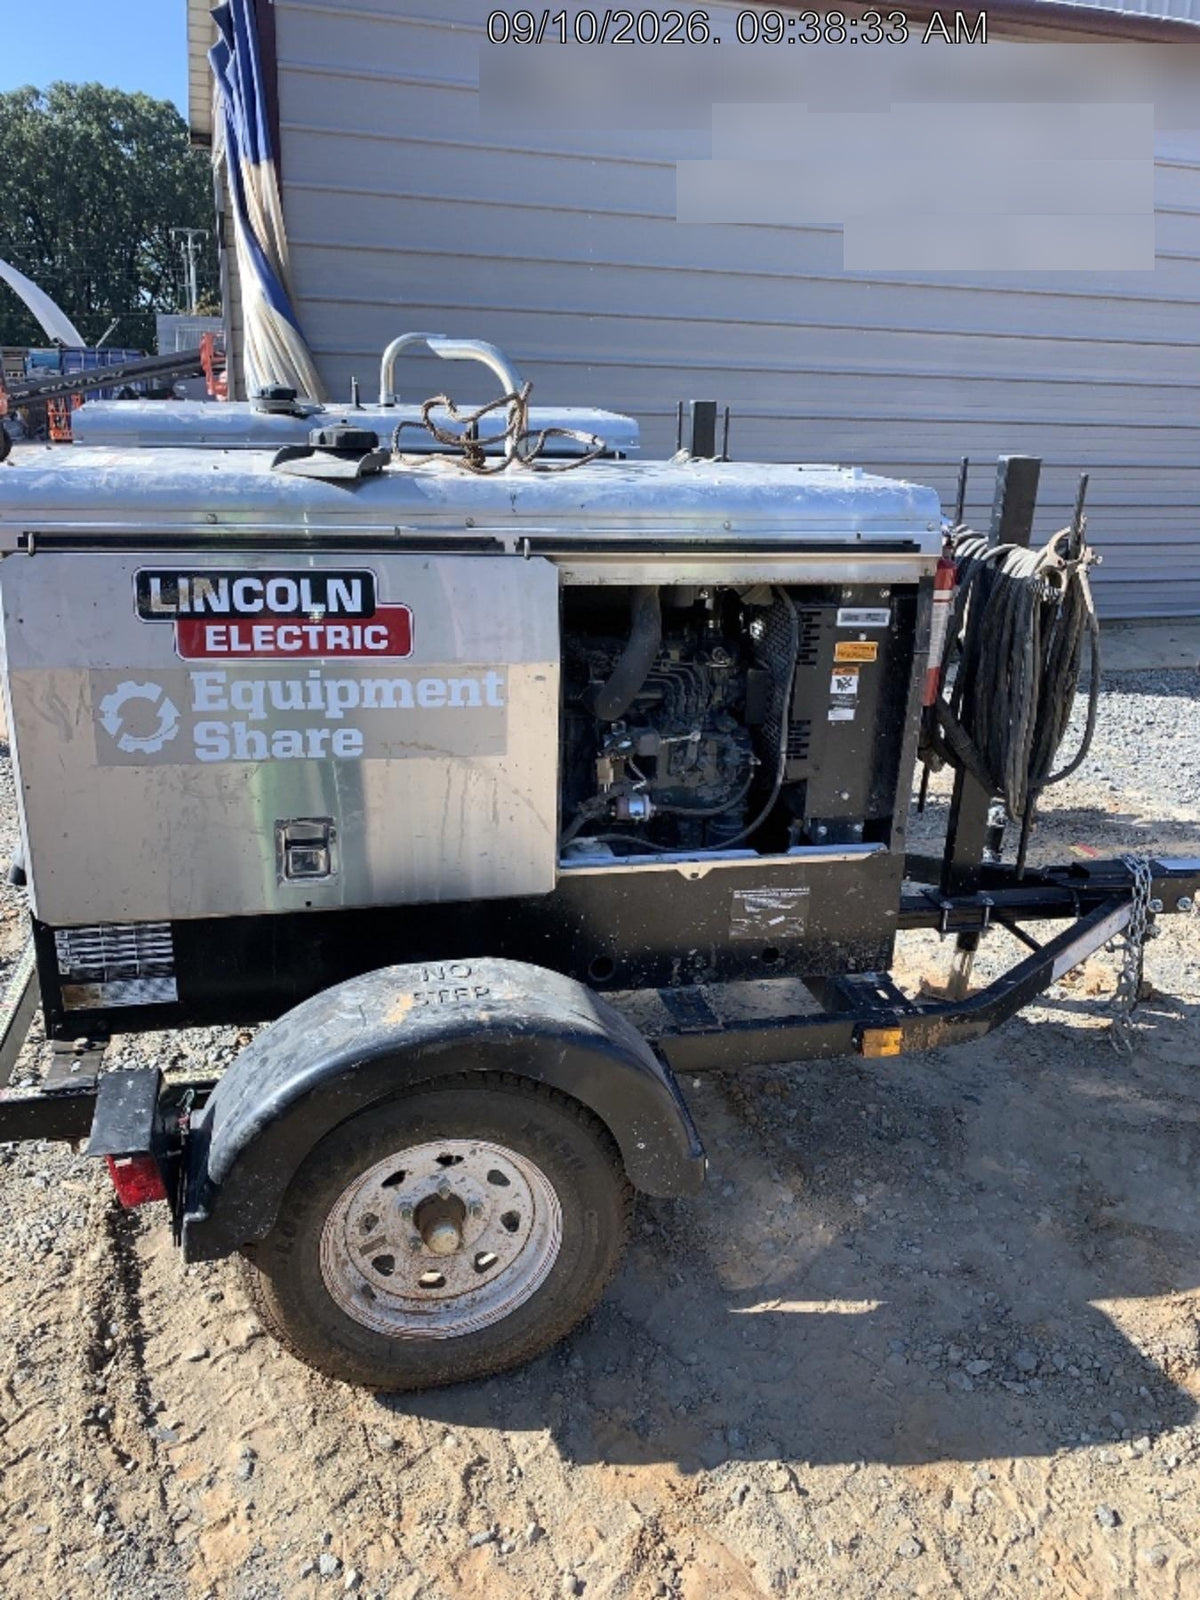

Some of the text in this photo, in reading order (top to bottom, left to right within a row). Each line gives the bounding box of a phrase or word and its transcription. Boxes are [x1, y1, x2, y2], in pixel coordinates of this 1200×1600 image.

[149, 577, 363, 613] LINCOLN
[205, 625, 389, 651] ELECTRIC
[189, 669, 505, 720] Equipment
[192, 720, 364, 762] Share
[422, 964, 473, 982] NO
[413, 985, 491, 1006] STEP
